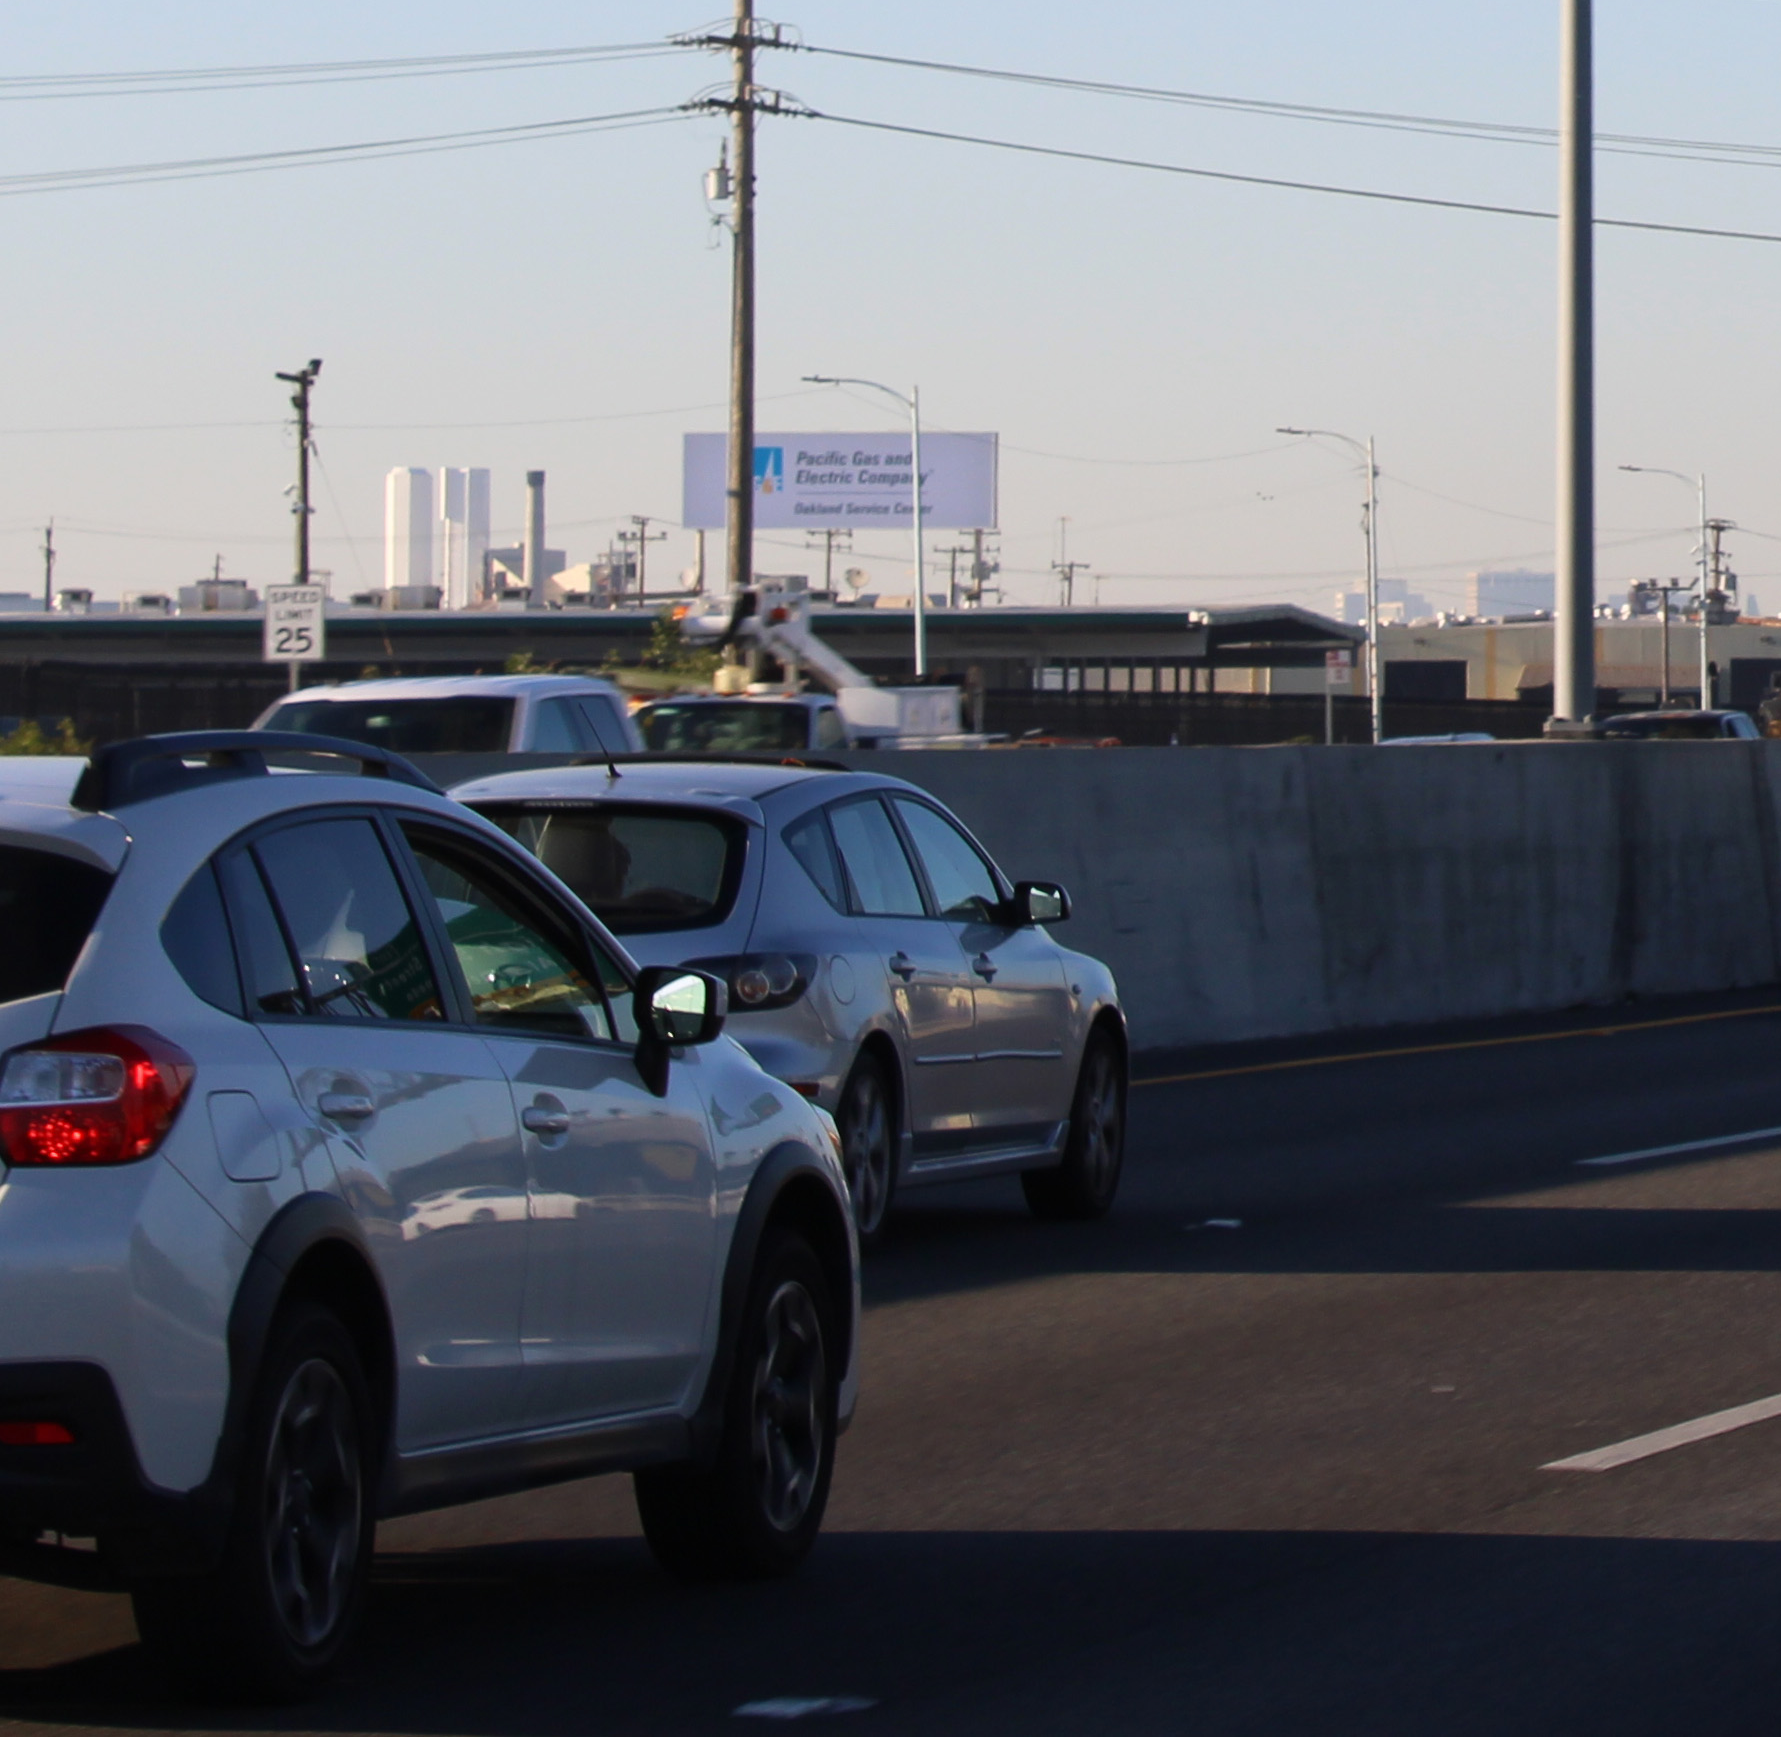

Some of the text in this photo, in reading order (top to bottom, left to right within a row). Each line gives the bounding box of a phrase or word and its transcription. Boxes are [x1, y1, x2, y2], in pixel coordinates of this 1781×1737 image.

[796, 450, 913, 466] Pacific Gas and
[795, 469, 853, 484] Electric
[794, 502, 933, 515] Oakland Service Ceer
[271, 591, 319, 604] SPEED
[275, 608, 313, 621] LIMIT
[275, 627, 313, 654] 25
